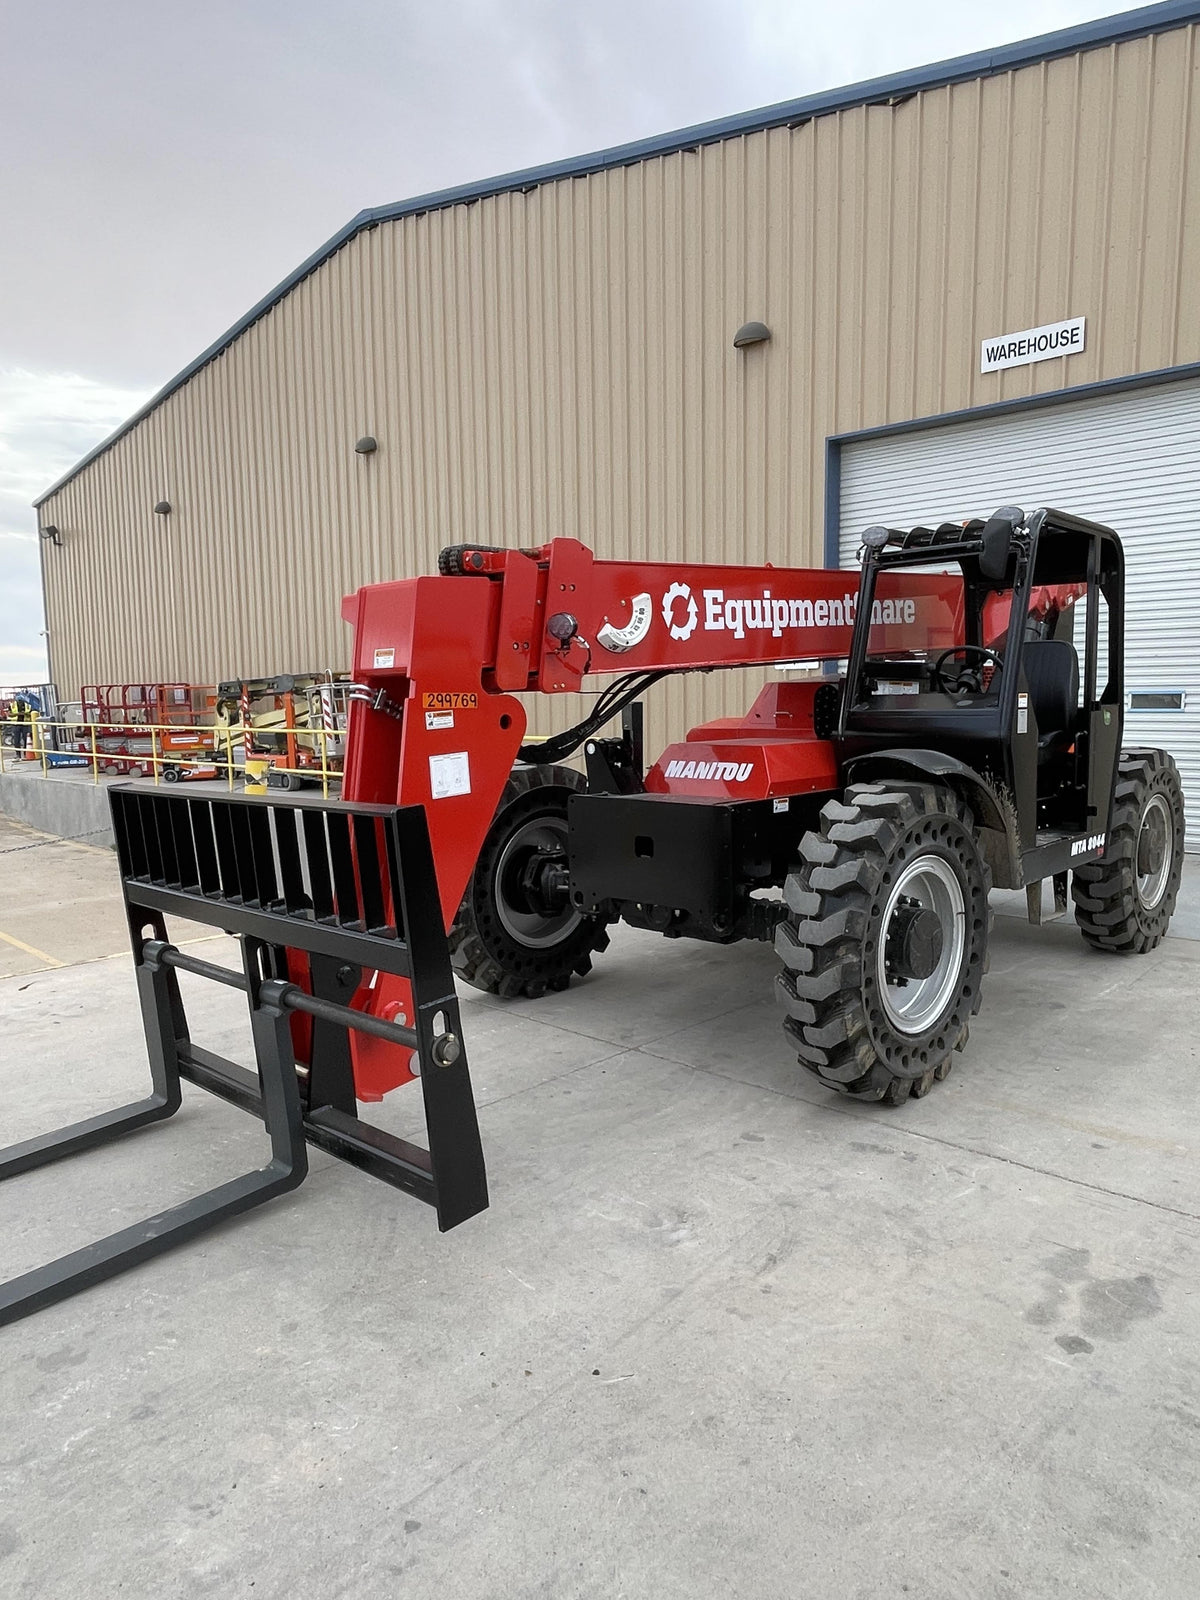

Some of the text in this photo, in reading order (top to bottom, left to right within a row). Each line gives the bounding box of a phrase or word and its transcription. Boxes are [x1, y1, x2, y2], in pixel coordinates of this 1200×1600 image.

[986, 326, 1080, 363] WAREHOUSE
[427, 693, 477, 708] 299769
[664, 760, 754, 782] MANITOU
[1071, 839, 1086, 856] MTA
